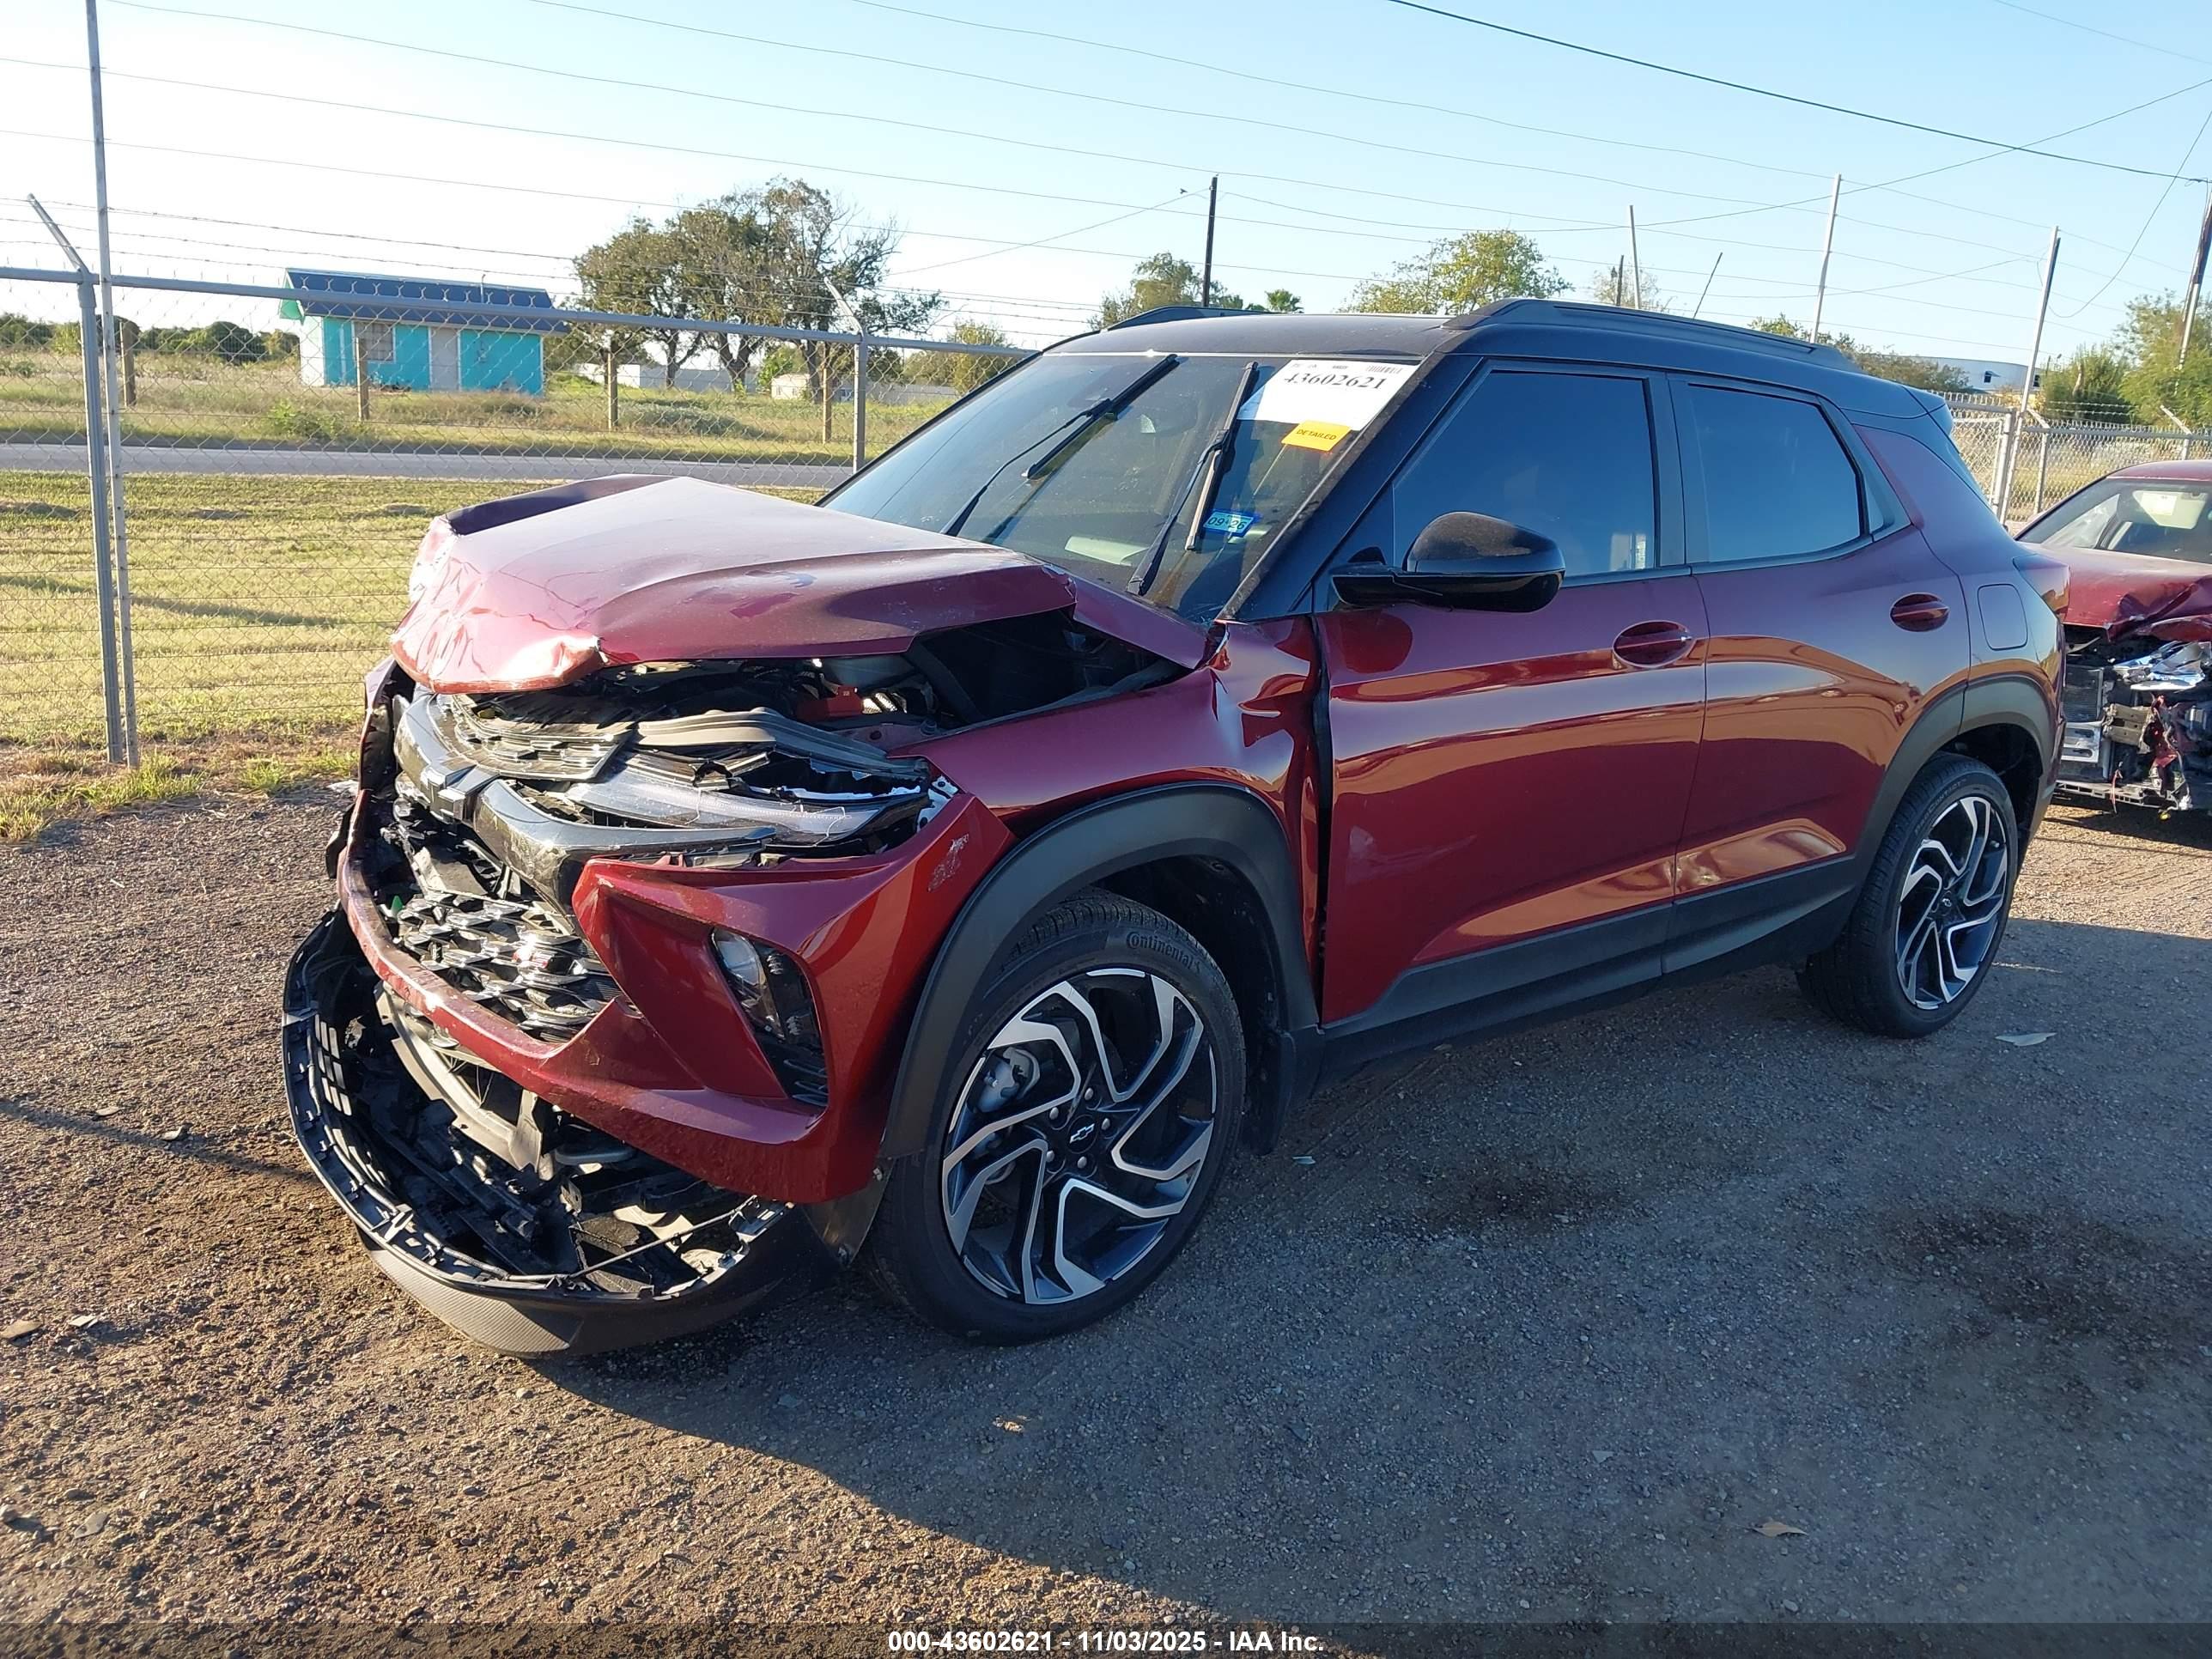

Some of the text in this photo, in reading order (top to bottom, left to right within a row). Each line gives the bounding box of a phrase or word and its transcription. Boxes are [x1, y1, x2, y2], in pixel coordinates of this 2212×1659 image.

[1285, 373, 1387, 389] 43602621
[1297, 429, 1337, 440] DETAILED
[1207, 517, 1224, 526] 09
[1228, 520, 1247, 529] 26
[1127, 932, 1194, 969] Continental
